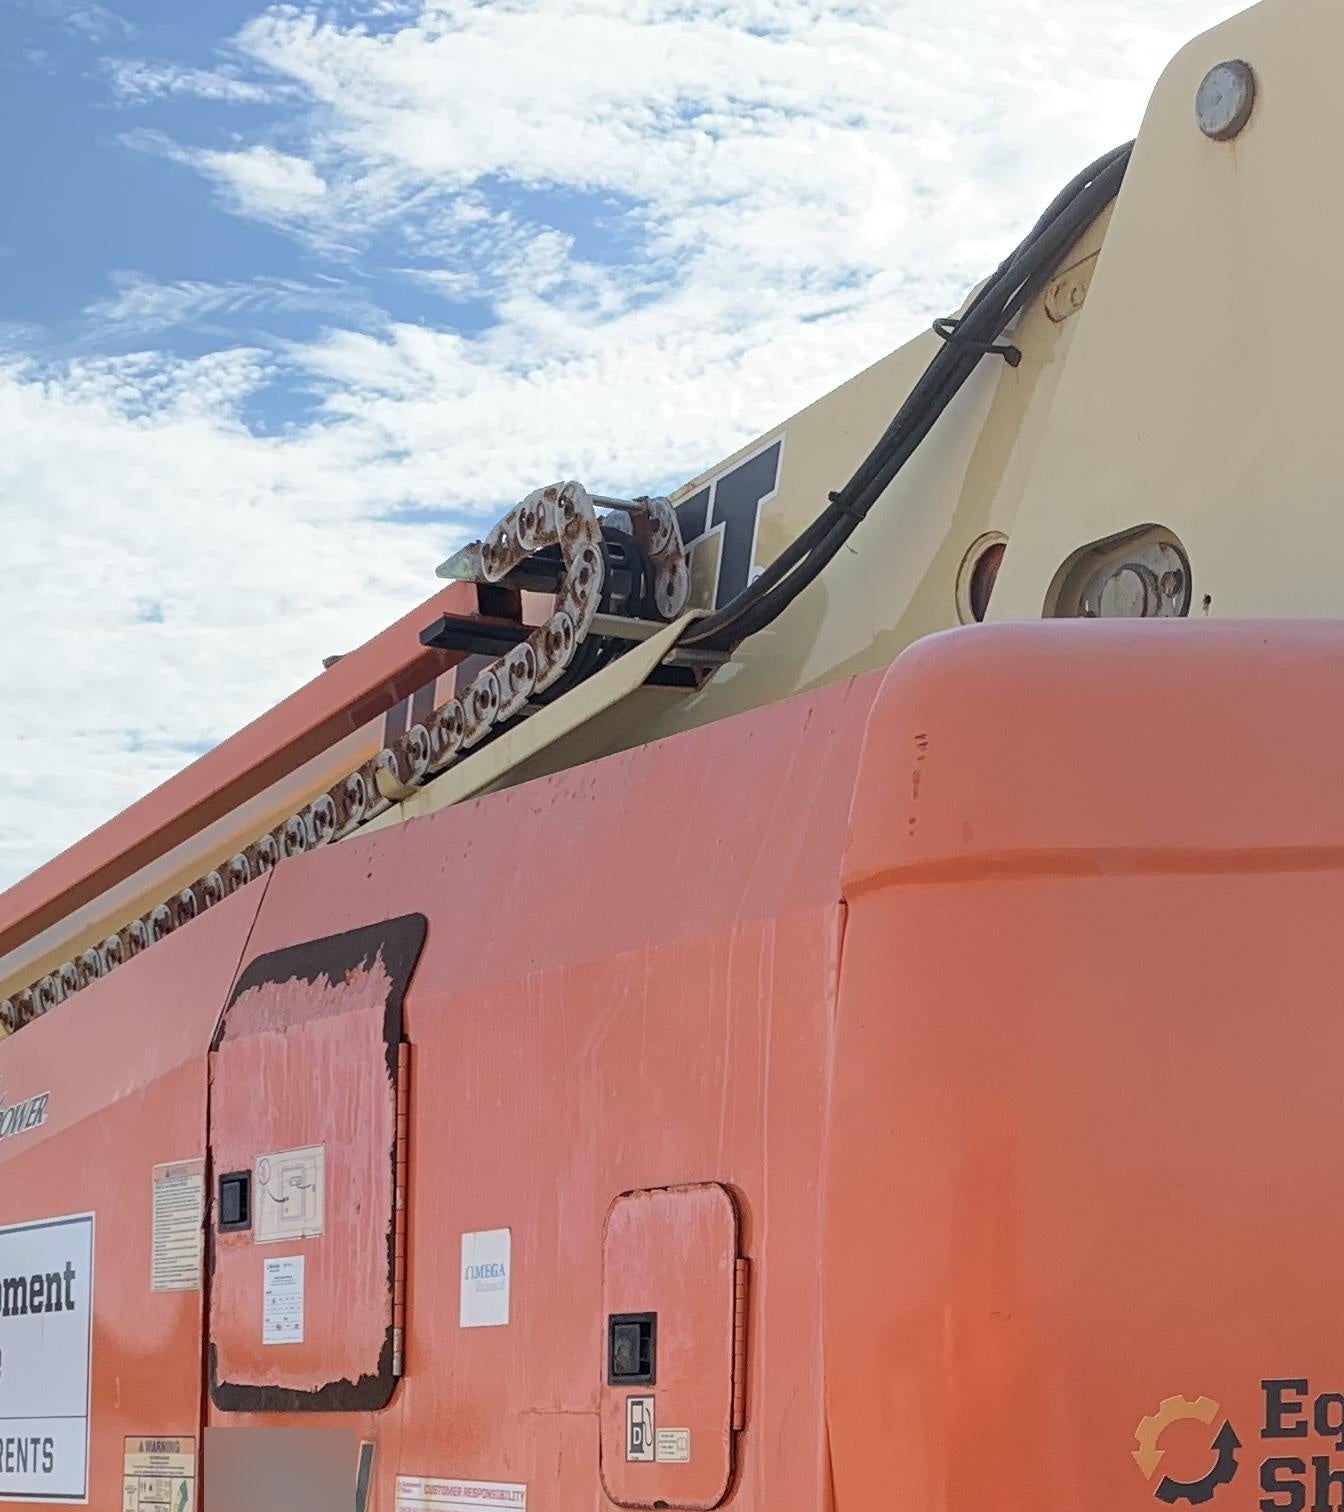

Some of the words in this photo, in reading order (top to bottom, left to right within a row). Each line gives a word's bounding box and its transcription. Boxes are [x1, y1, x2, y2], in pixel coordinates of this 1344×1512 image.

[144, 1440, 181, 1454] WARNING
[424, 1484, 462, 1497] CUSTOMER
[463, 1486, 524, 1502] RESPONSIBILITY
